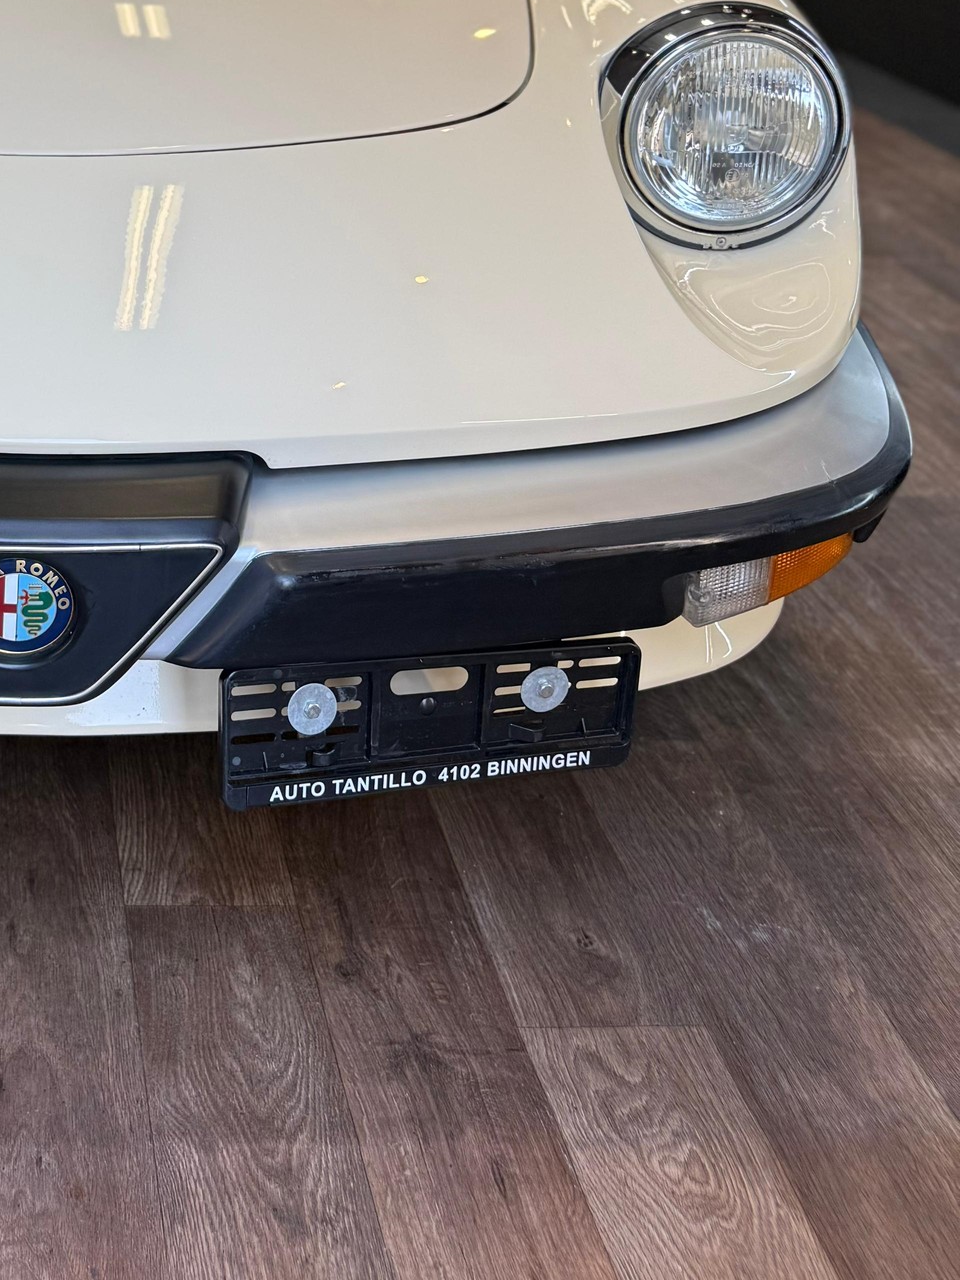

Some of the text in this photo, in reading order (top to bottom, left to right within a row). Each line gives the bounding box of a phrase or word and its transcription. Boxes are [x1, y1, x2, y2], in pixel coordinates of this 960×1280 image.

[15, 559, 70, 610] ROMEO
[269, 750, 591, 802] AUTO TANTILLO 4102 BINNINGEN
